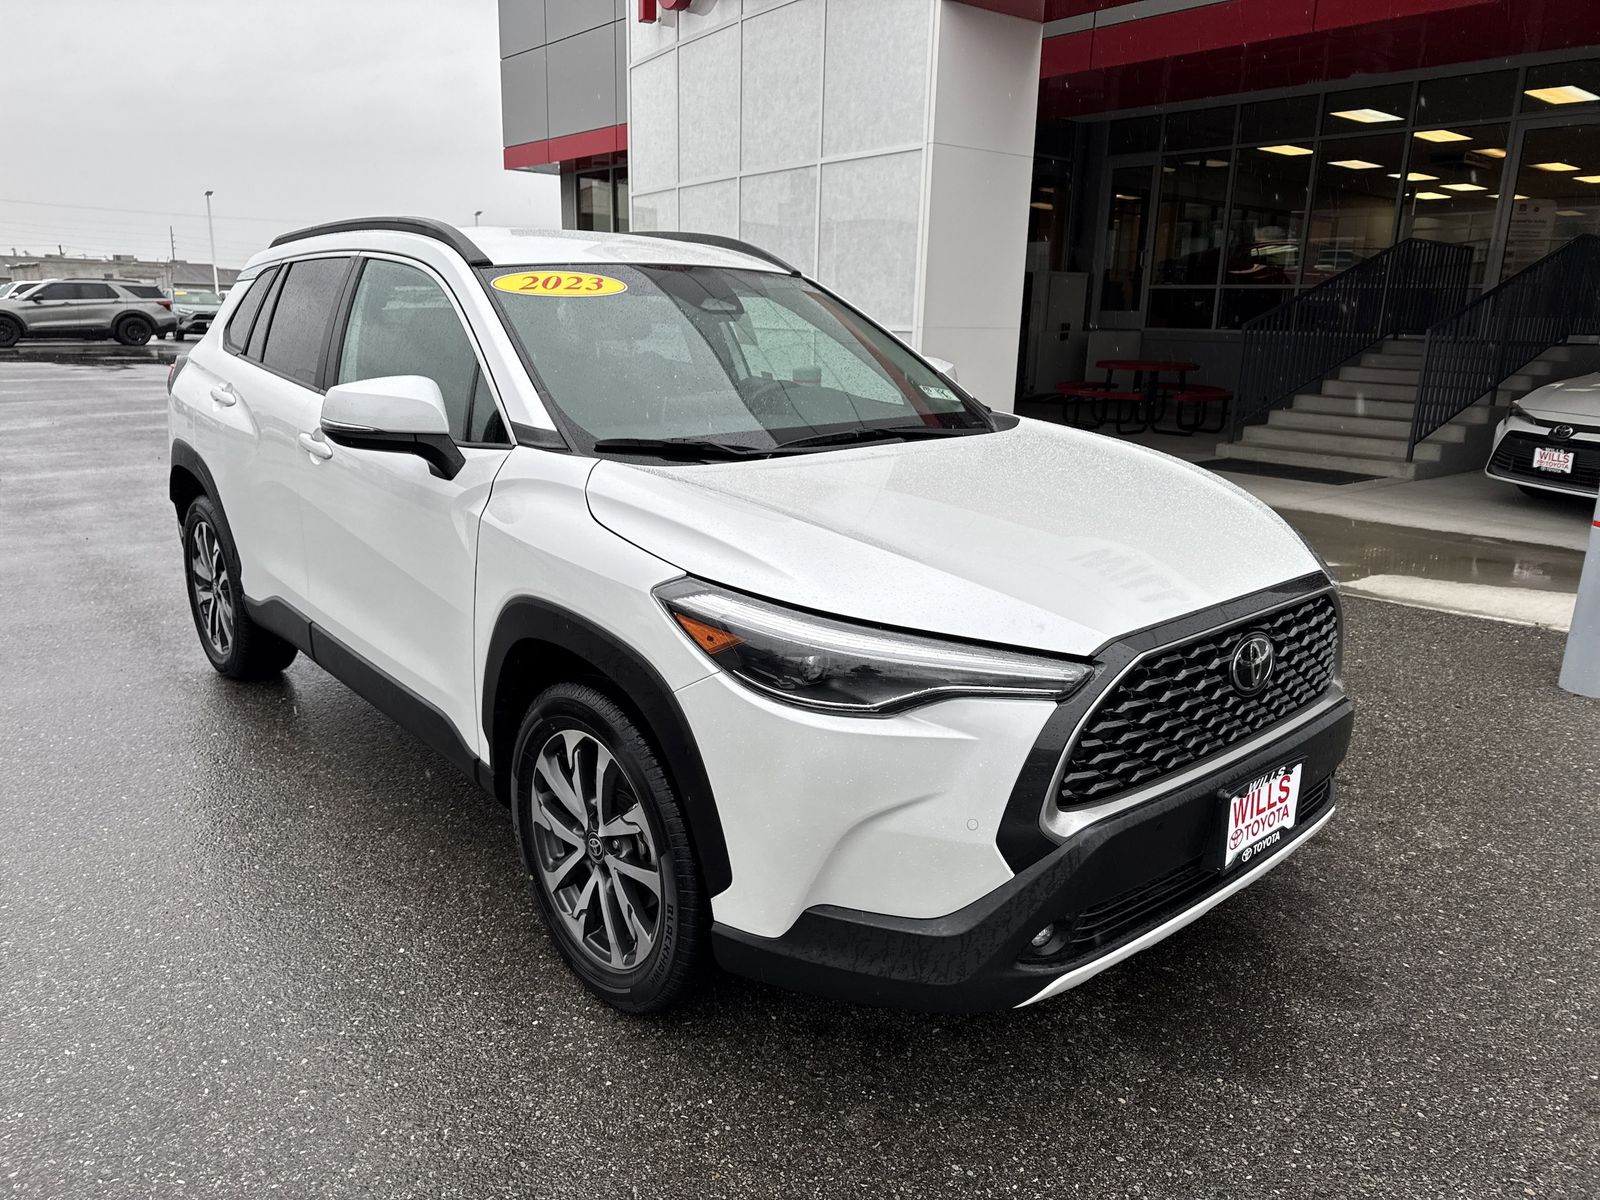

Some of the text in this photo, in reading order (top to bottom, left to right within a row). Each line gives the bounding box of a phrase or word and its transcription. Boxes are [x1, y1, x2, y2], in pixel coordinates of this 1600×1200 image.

[519, 275, 604, 291] 2023
[1539, 451, 1570, 464] WILLS
[1546, 461, 1569, 470] TOYOTA
[1248, 766, 1286, 793] WILLS
[1233, 775, 1290, 828] WILLS
[1244, 804, 1290, 841] TOYOTA
[1253, 831, 1280, 854] TOYOTA
[649, 903, 674, 985] BLACKHAWK
